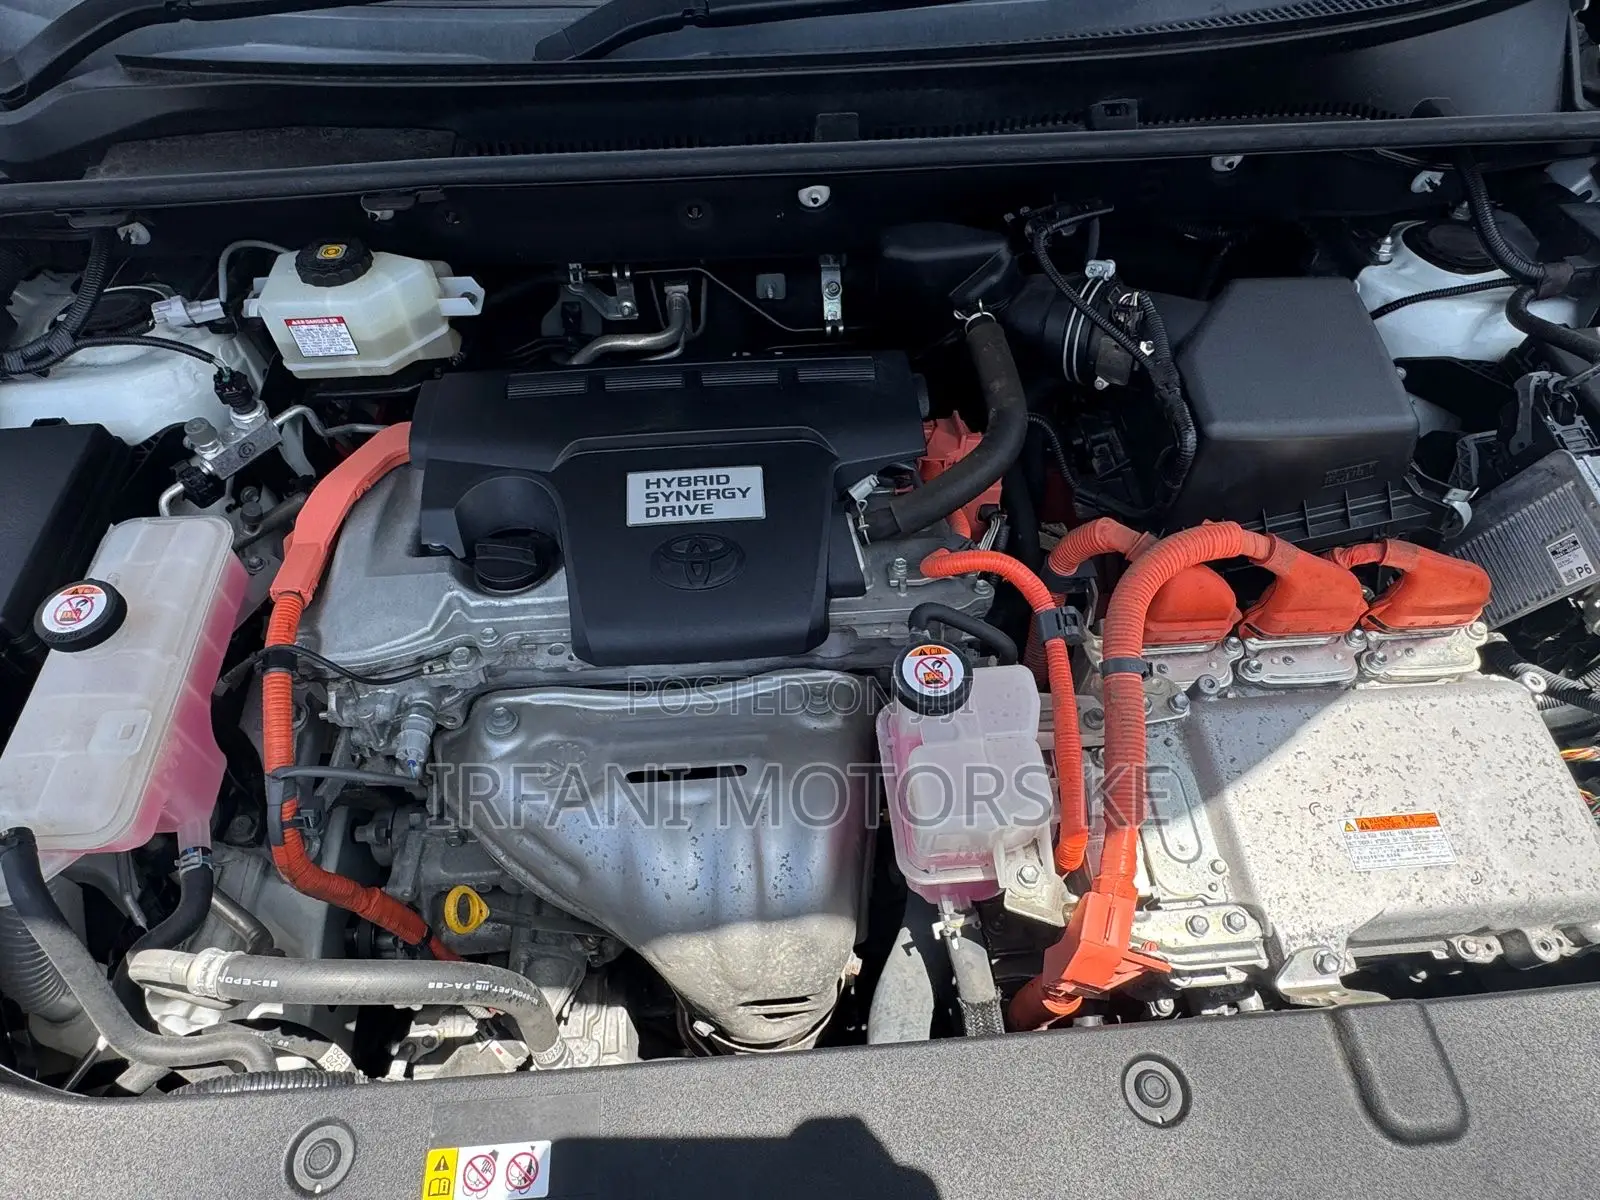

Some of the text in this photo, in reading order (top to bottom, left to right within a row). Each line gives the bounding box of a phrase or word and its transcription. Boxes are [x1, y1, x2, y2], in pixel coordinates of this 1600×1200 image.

[645, 474, 731, 489] HYBRID
[645, 486, 752, 504] SYNERGY
[645, 503, 714, 519] DRIVE
[1575, 563, 1592, 578] P6
